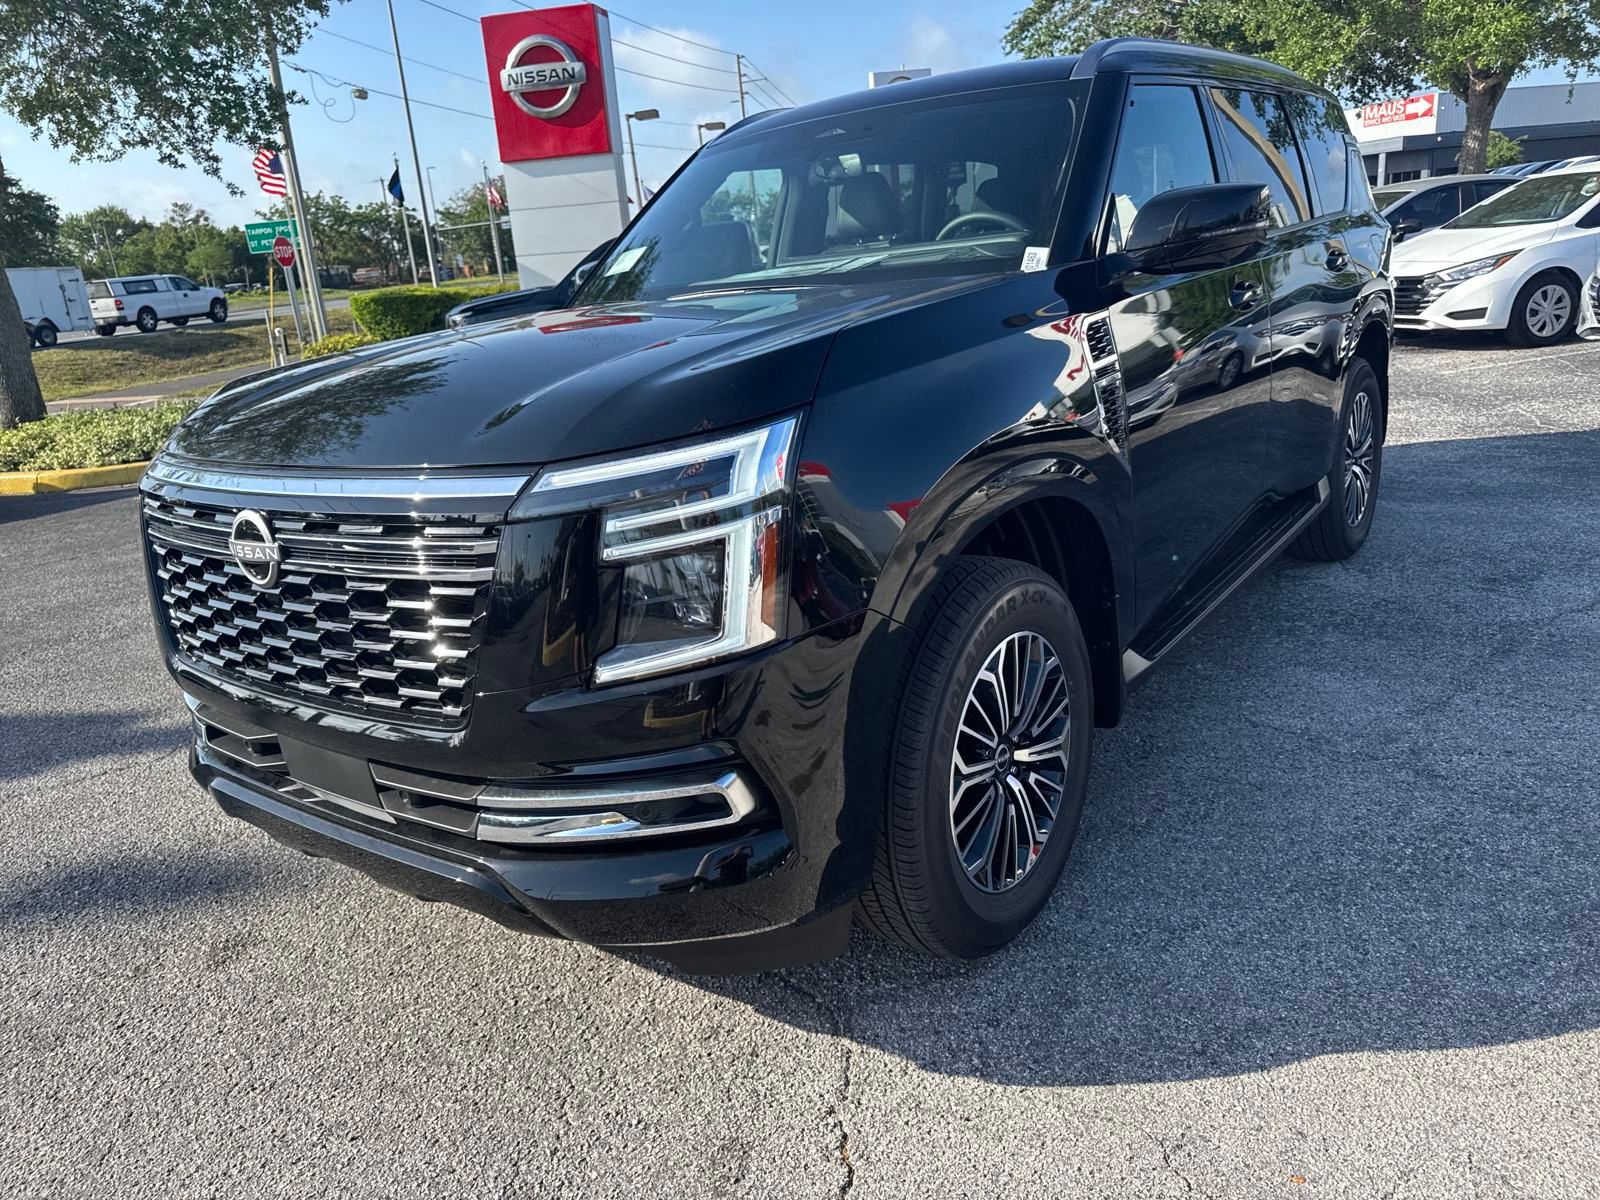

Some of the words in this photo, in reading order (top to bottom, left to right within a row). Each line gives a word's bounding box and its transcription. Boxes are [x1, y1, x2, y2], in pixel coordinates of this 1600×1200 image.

[507, 67, 576, 86] NISSAN
[1365, 100, 1405, 120] MAUS
[248, 227, 273, 235] TARPON
[275, 246, 292, 258] STOP
[229, 542, 279, 560] NISSAN
